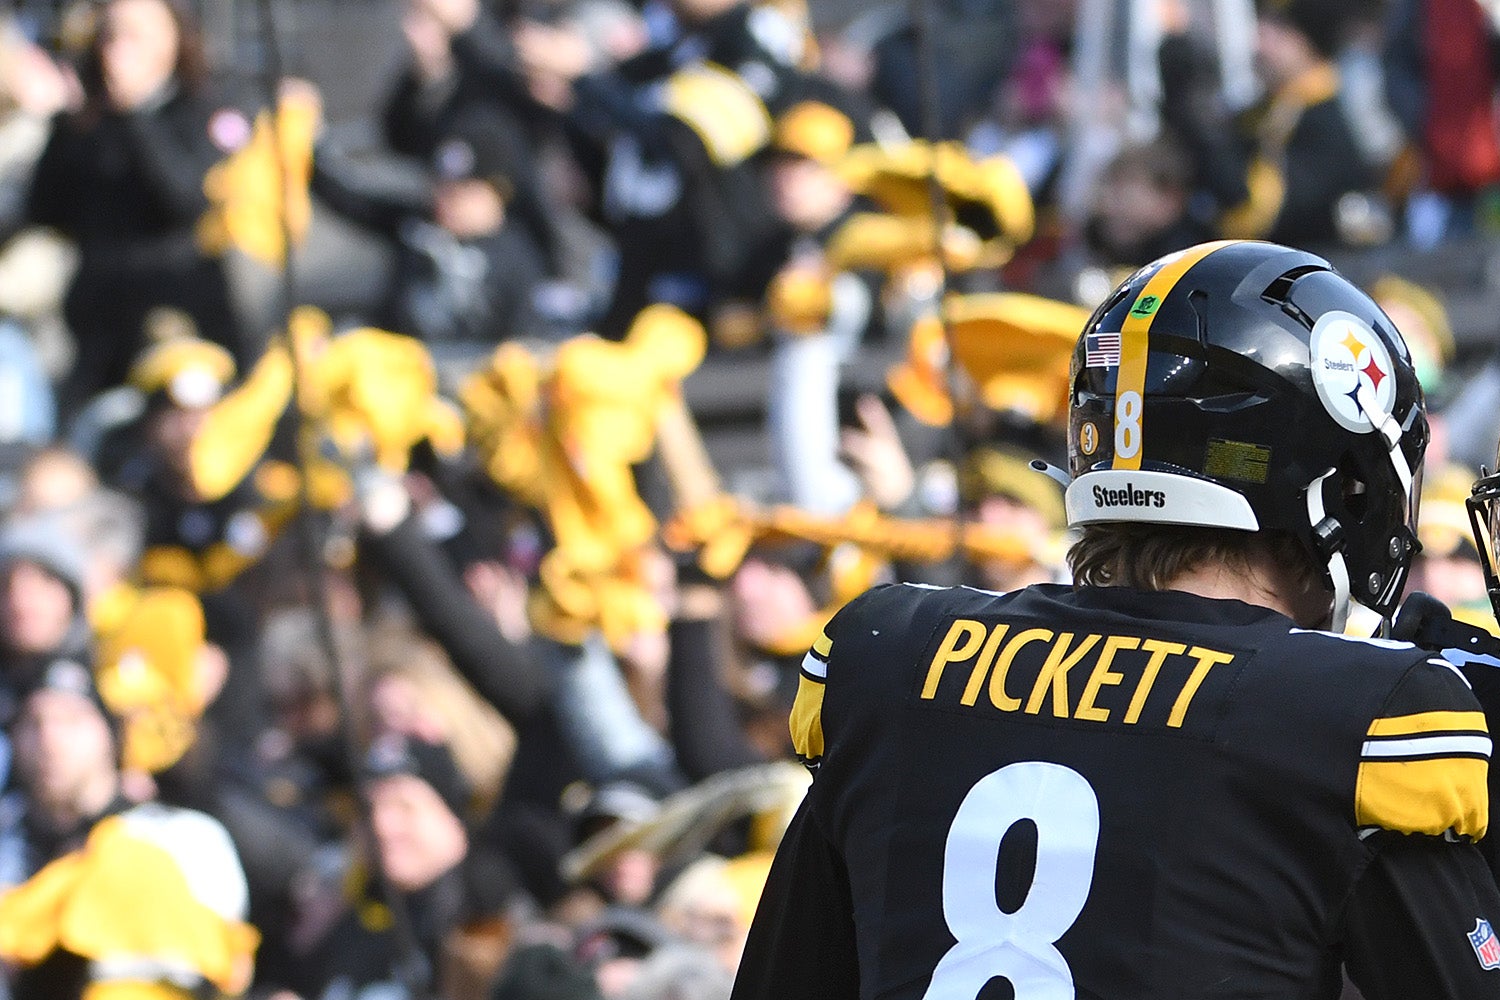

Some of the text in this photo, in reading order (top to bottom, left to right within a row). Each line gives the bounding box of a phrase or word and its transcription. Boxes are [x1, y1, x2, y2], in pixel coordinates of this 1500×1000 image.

[1324, 357, 1355, 372] Steelers
[1084, 423, 1094, 452] 3
[1115, 390, 1143, 459] 8
[1092, 483, 1166, 509] Steelers
[919, 618, 1236, 729] PICKETT
